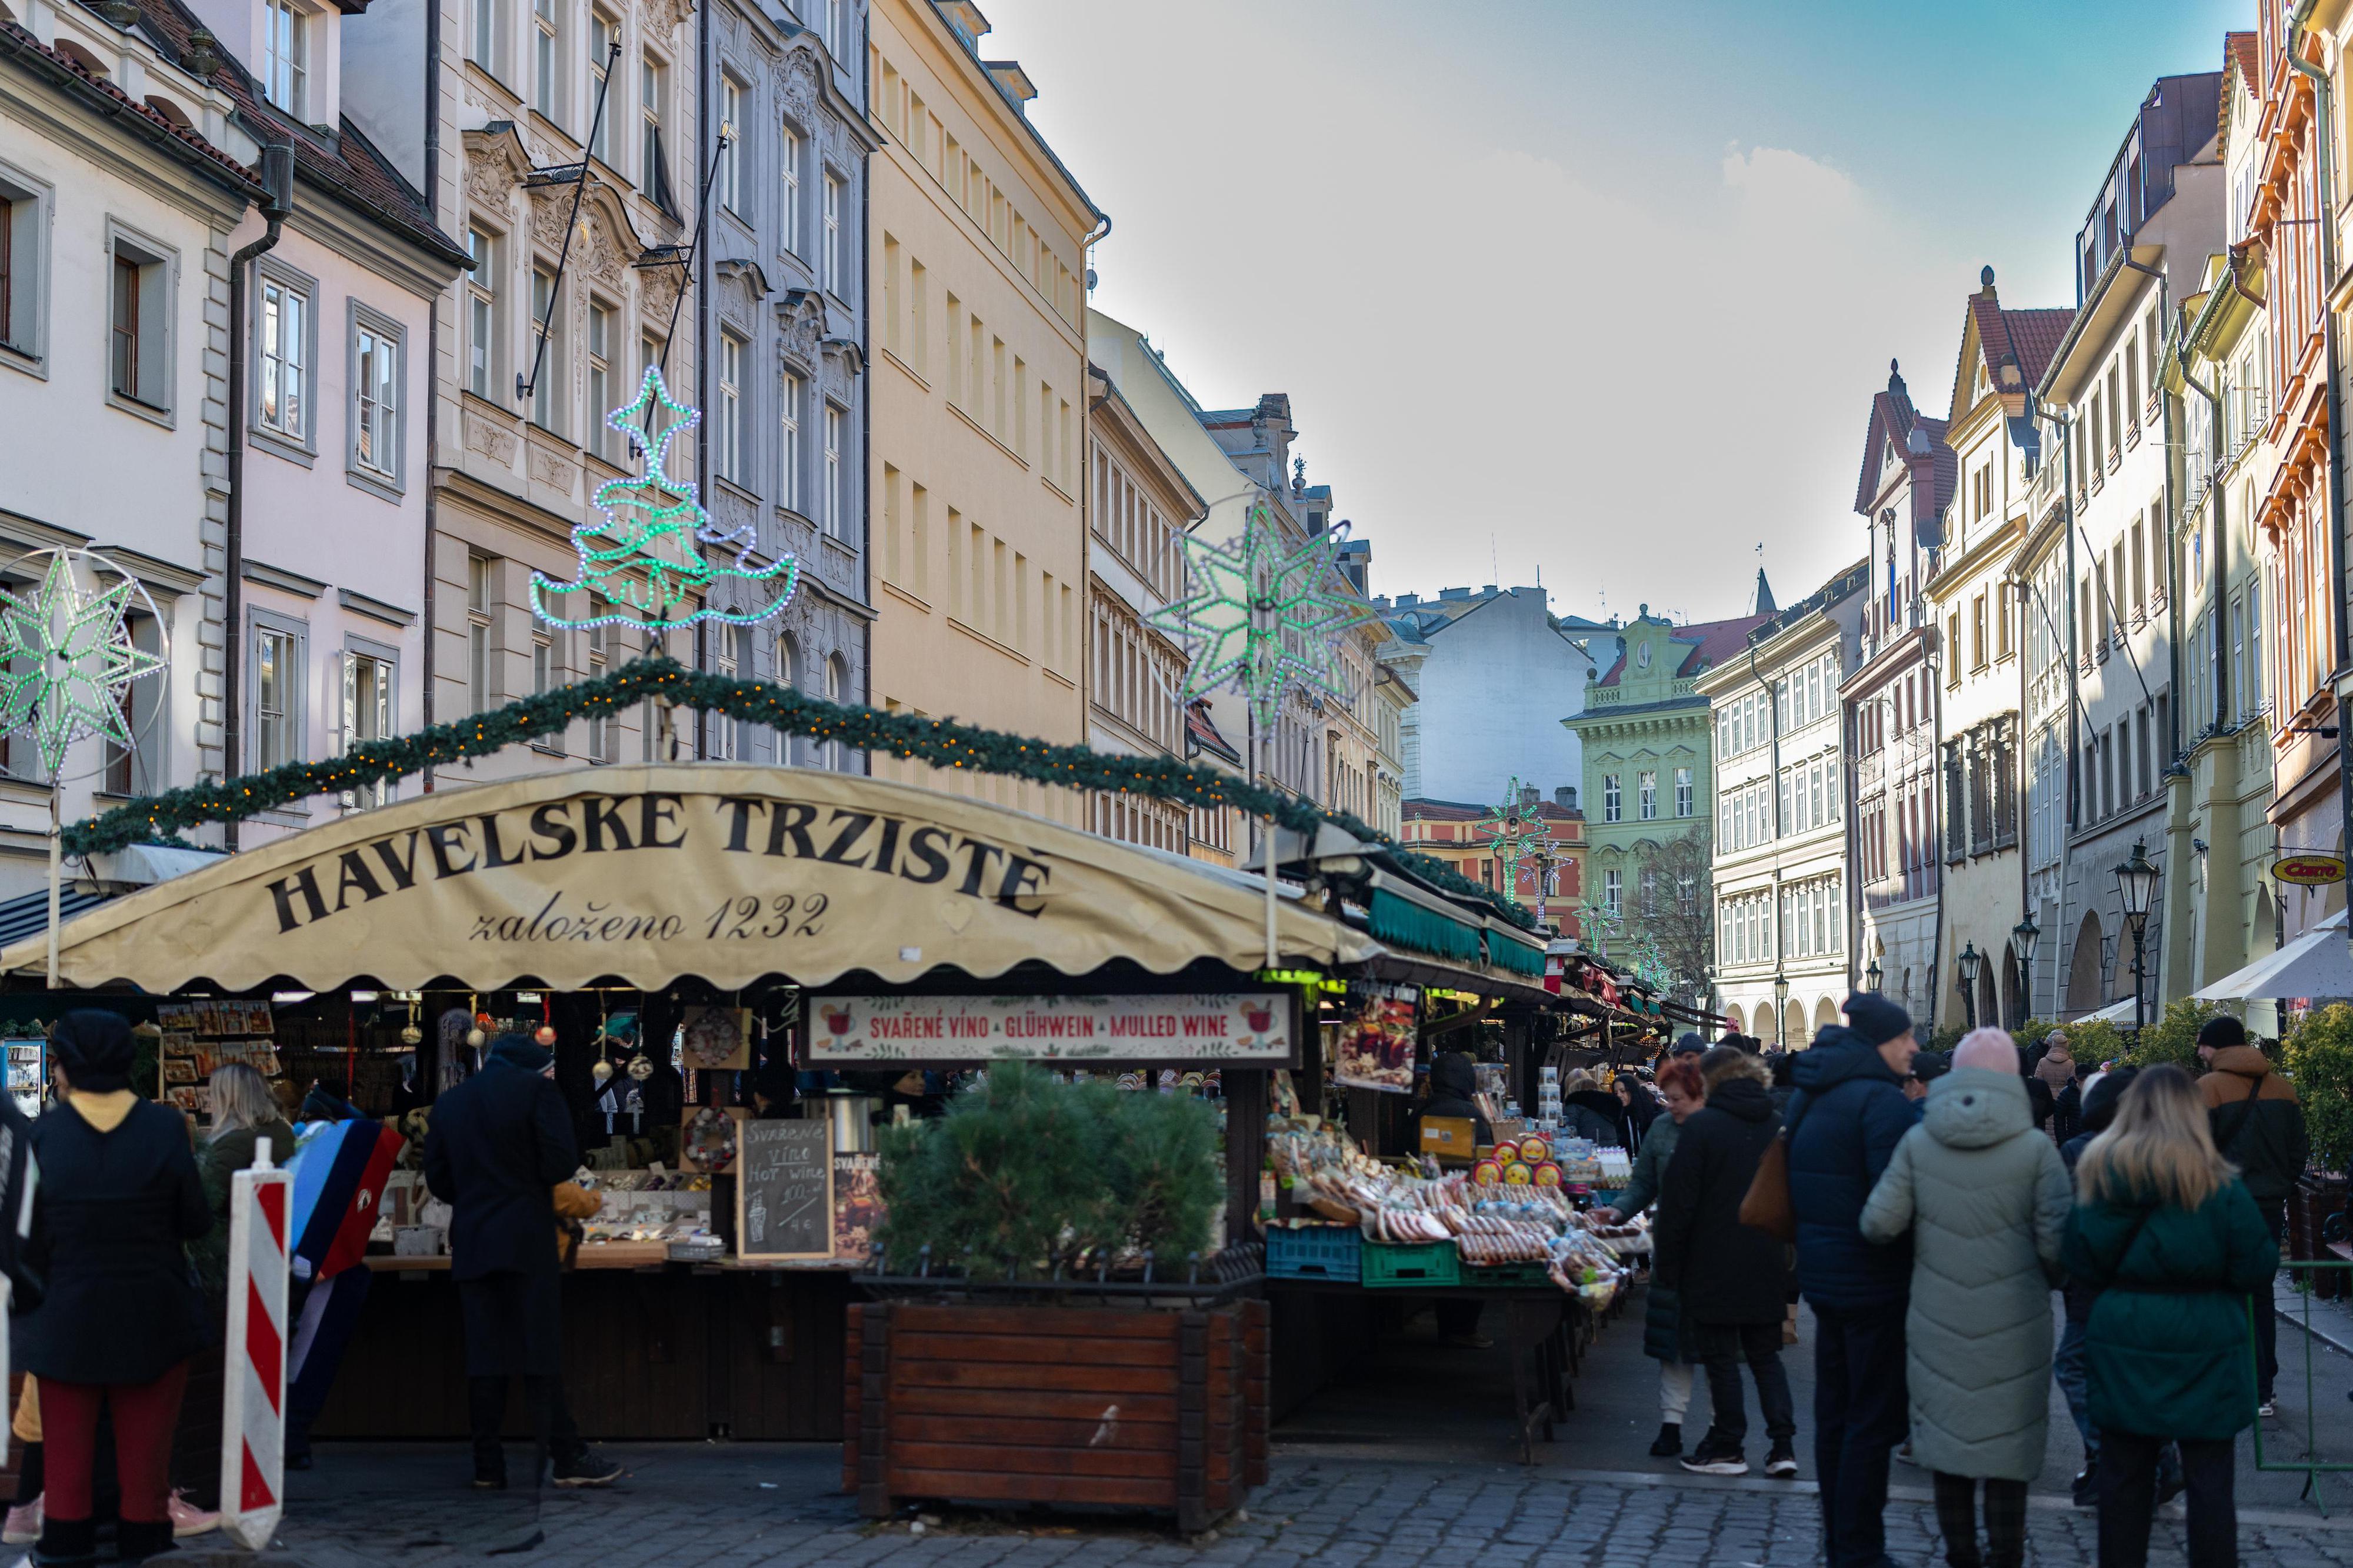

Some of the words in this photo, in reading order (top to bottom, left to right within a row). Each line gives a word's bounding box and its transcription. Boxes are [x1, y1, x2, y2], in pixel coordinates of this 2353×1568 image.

[469, 890, 685, 942] založeno
[705, 892, 829, 939] 1232
[870, 1008, 944, 1039] SVAŘENÉ
[948, 1006, 989, 1038] VÍNO
[1005, 1010, 1094, 1038] GLÜHWEIN
[1109, 1015, 1176, 1037] MULLED
[1181, 1015, 1228, 1037] WINE
